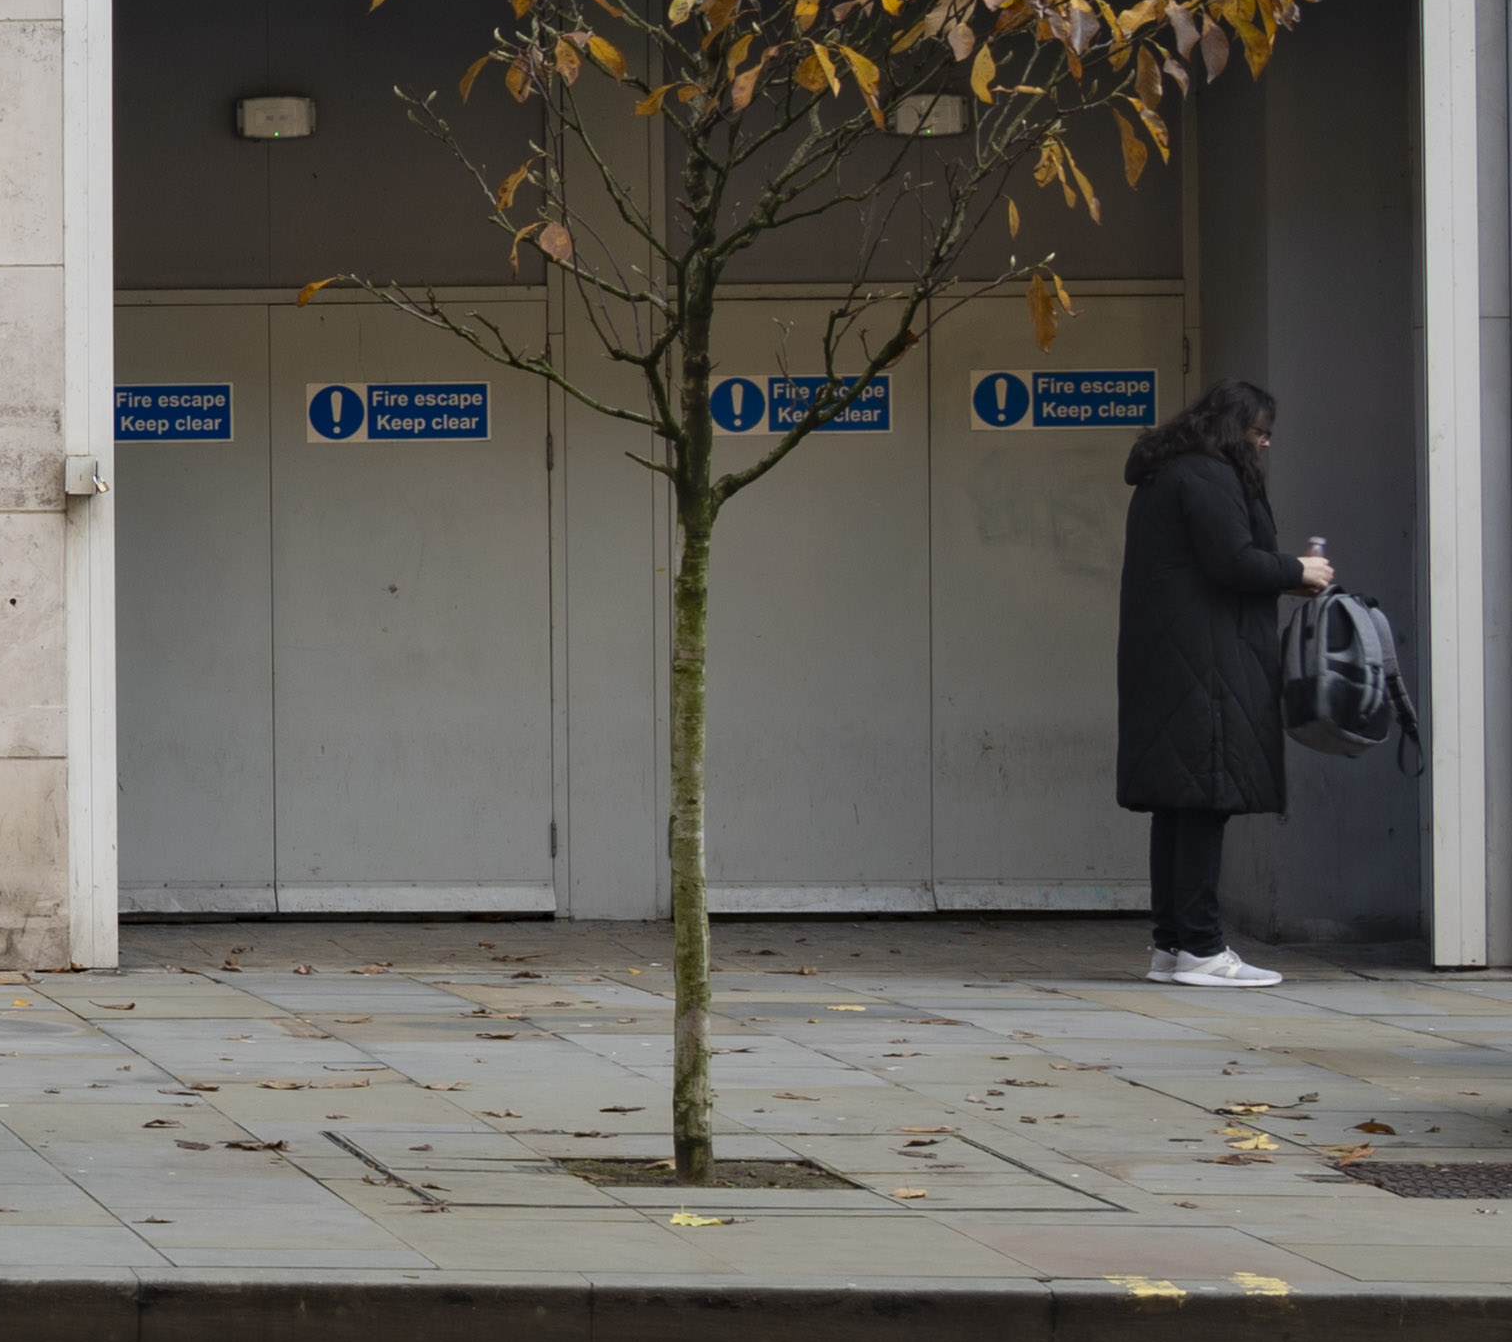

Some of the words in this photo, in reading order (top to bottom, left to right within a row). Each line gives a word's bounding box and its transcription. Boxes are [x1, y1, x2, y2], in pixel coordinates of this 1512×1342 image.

[773, 383, 810, 399] Fire
[1037, 378, 1075, 394] Fire
[1080, 380, 1151, 397] escape
[116, 392, 152, 408] Fire
[158, 394, 226, 410] escape
[372, 391, 409, 407] Fire
[414, 393, 483, 409] escape
[1042, 402, 1092, 421] Keep
[1098, 401, 1147, 417] clear
[120, 416, 169, 435] Keep
[175, 415, 222, 431] clear
[377, 414, 426, 434] Keep
[431, 414, 479, 430] clear
